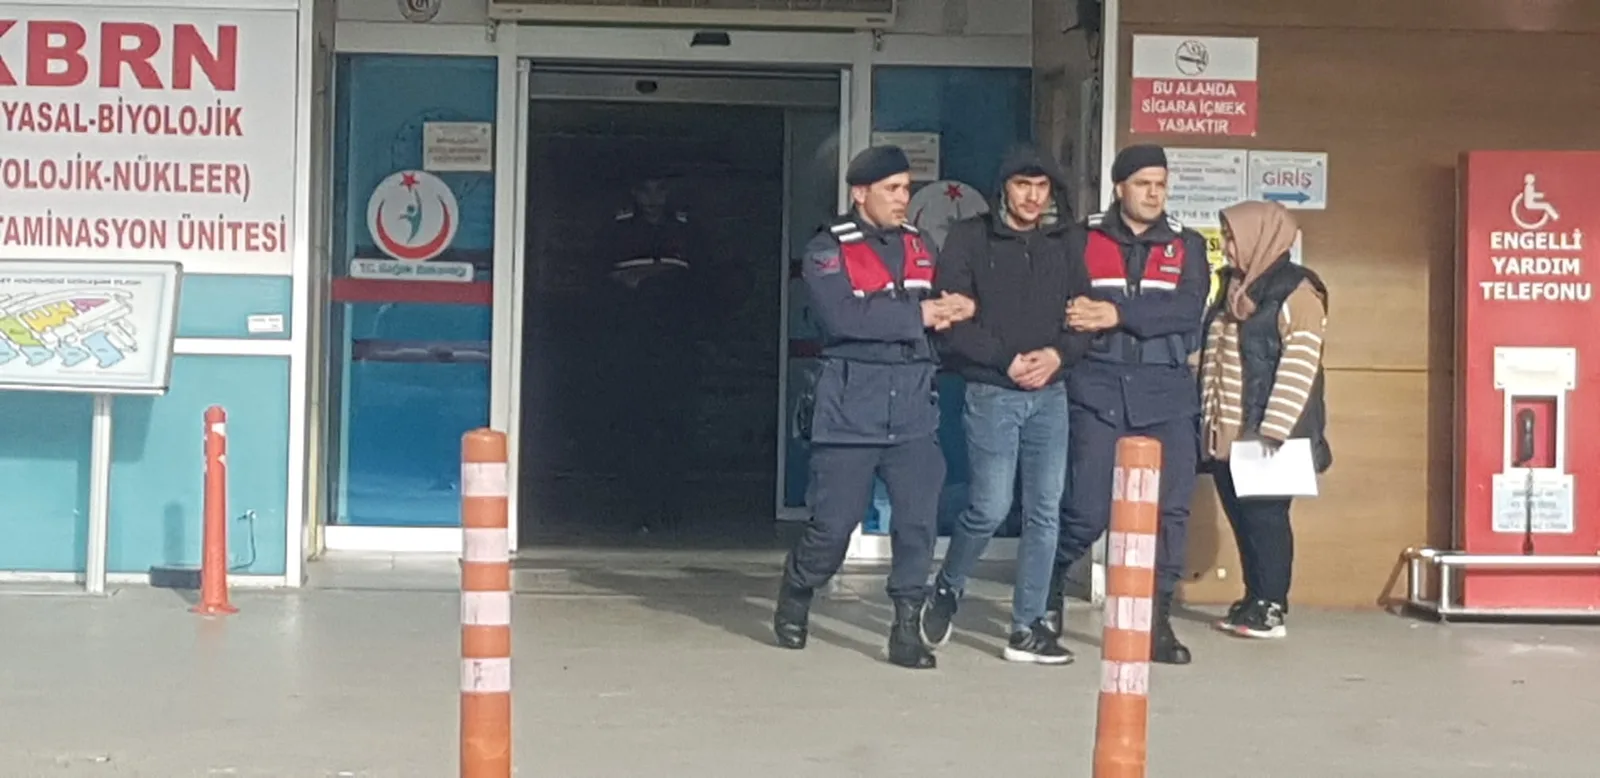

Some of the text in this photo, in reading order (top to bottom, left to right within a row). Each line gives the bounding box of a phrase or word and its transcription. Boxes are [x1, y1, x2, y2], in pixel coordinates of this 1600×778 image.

[0, 20, 238, 91] BRN
[1152, 81, 1236, 97] BU ALANDA
[1142, 97, 1246, 117] SİGARA İÇMEK
[1158, 118, 1229, 134] YASAKTIR
[0, 152, 250, 202] OLOJİK-NÜKLEER)
[178, 213, 286, 252] ÜNİTESİ
[1490, 229, 1582, 250] ENGELLİ
[1491, 257, 1581, 275] YARDIM
[1479, 281, 1592, 300] TELEFONU
